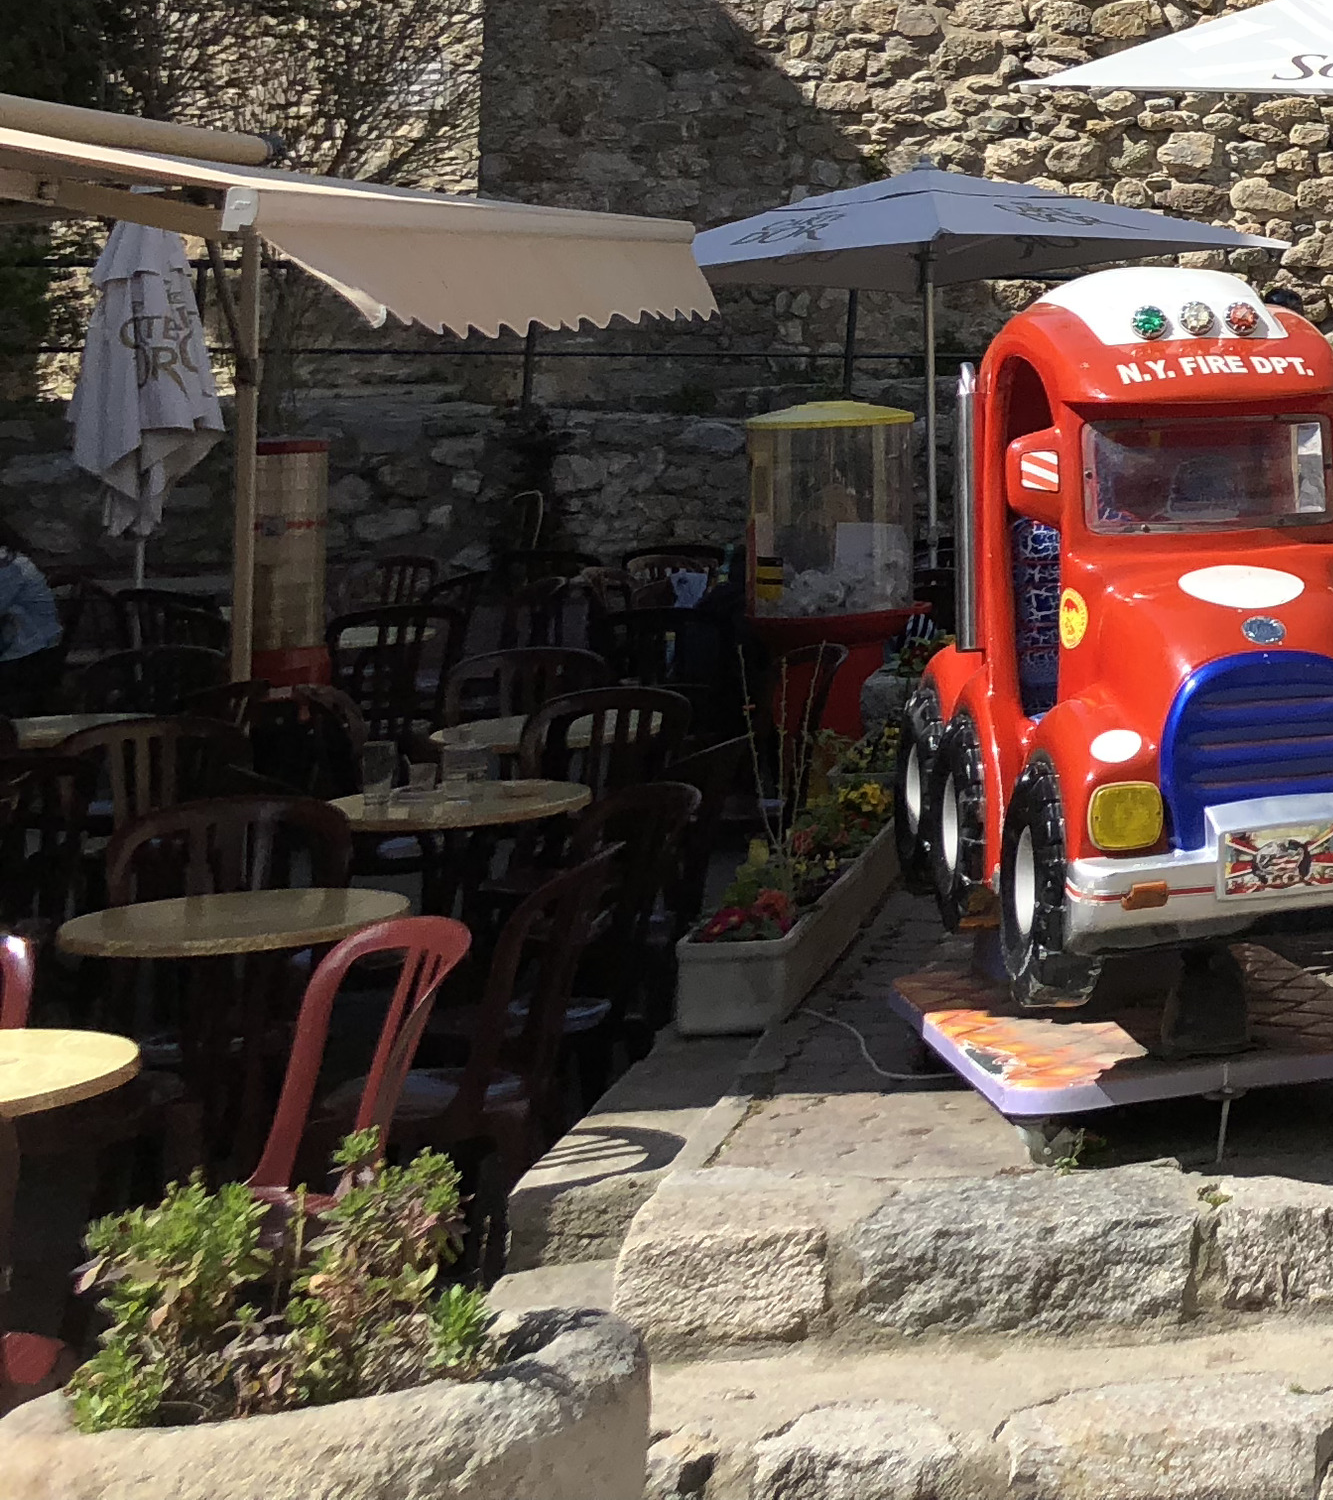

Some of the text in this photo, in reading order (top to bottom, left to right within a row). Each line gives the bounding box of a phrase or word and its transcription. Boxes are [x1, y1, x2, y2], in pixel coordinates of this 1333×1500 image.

[1115, 355, 1316, 385] N.Y. FIRE DPT.
